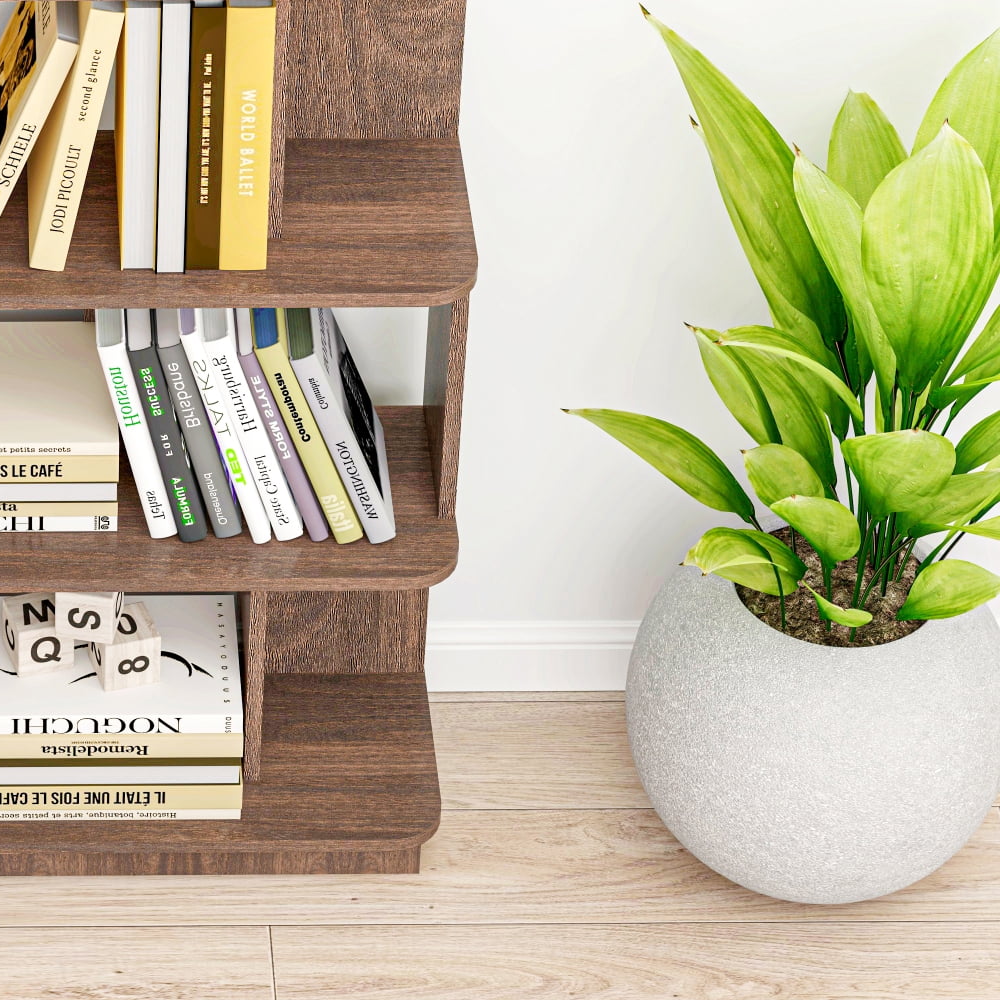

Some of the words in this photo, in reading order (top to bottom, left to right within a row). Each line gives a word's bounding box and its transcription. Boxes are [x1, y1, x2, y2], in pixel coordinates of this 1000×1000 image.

[78, 84, 94, 122] second
[86, 48, 103, 84] glance
[240, 89, 257, 142] WORLD
[56, 144, 82, 202] PICOULT
[238, 148, 257, 198] BALLET
[49, 202, 68, 233] JODI
[9, 446, 36, 454] petits
[11, 464, 27, 477] LE
[30, 461, 63, 477] CAFÉ
[67, 607, 101, 630] S
[30, 636, 62, 663] Q
[117, 655, 150, 675] 8
[11, 717, 182, 734] NOGUCHI
[224, 716, 232, 734] DUUS
[40, 745, 149, 757] Remodelista
[31, 792, 48, 805] LE
[51, 792, 81, 805] FOIS
[83, 791, 110, 805] UNE
[114, 791, 151, 807] ÉTAIT
[154, 791, 166, 804] IL
[22, 812, 49, 820] petits
[63, 811, 84, 819] arts
[86, 811, 134, 820] botanique,
[136, 811, 177, 819] Histoire,
